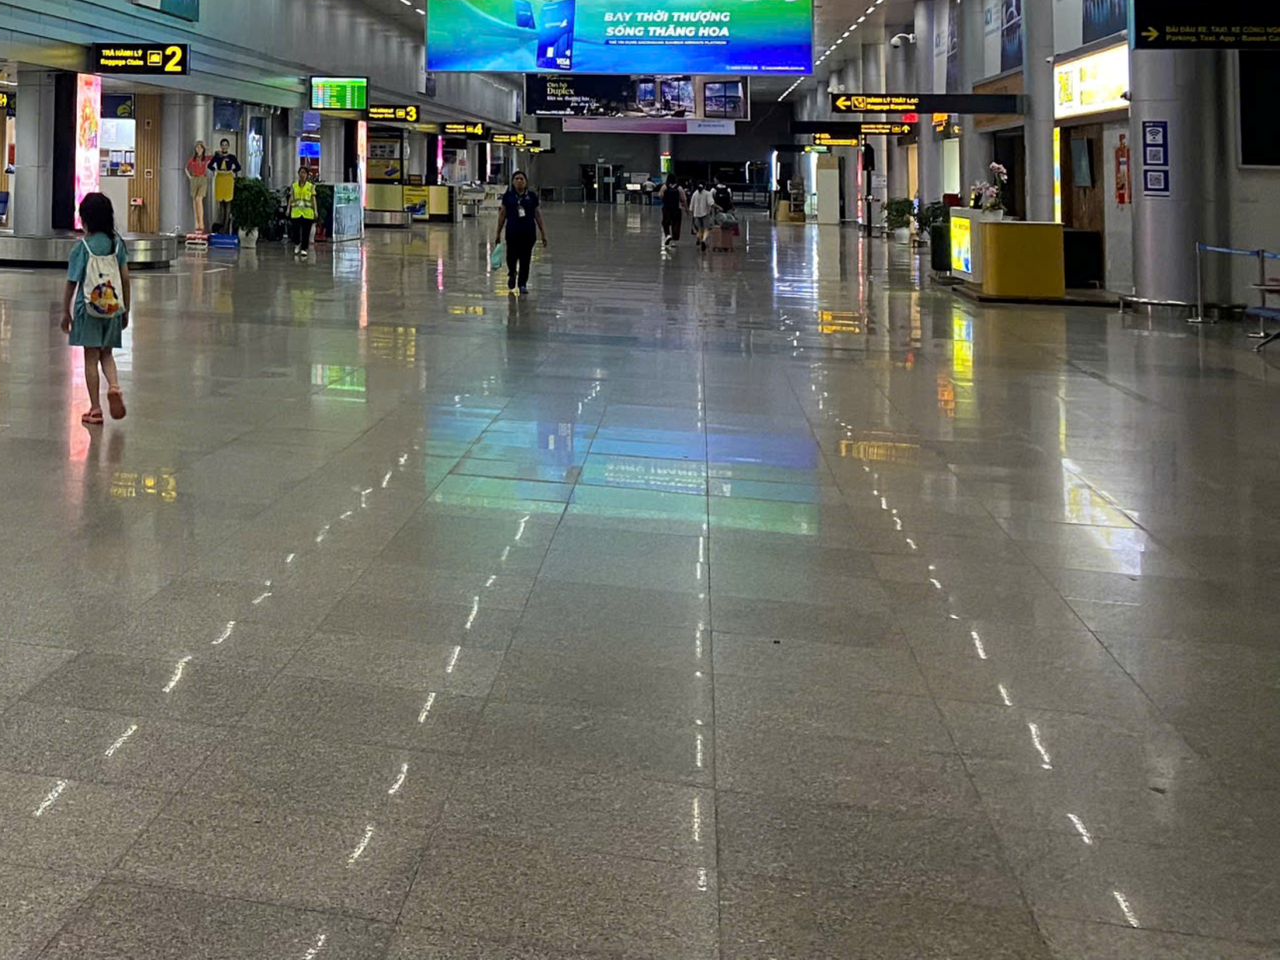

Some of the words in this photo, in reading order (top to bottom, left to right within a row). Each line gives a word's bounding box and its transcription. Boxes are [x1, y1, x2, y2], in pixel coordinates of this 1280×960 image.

[604, 12, 633, 22] BAY
[636, 9, 668, 23] THỜI
[699, 26, 730, 37] HOA
[164, 46, 183, 72] 2
[547, 88, 575, 96] Duplex
[406, 106, 417, 121] 3
[474, 123, 483, 135] 4
